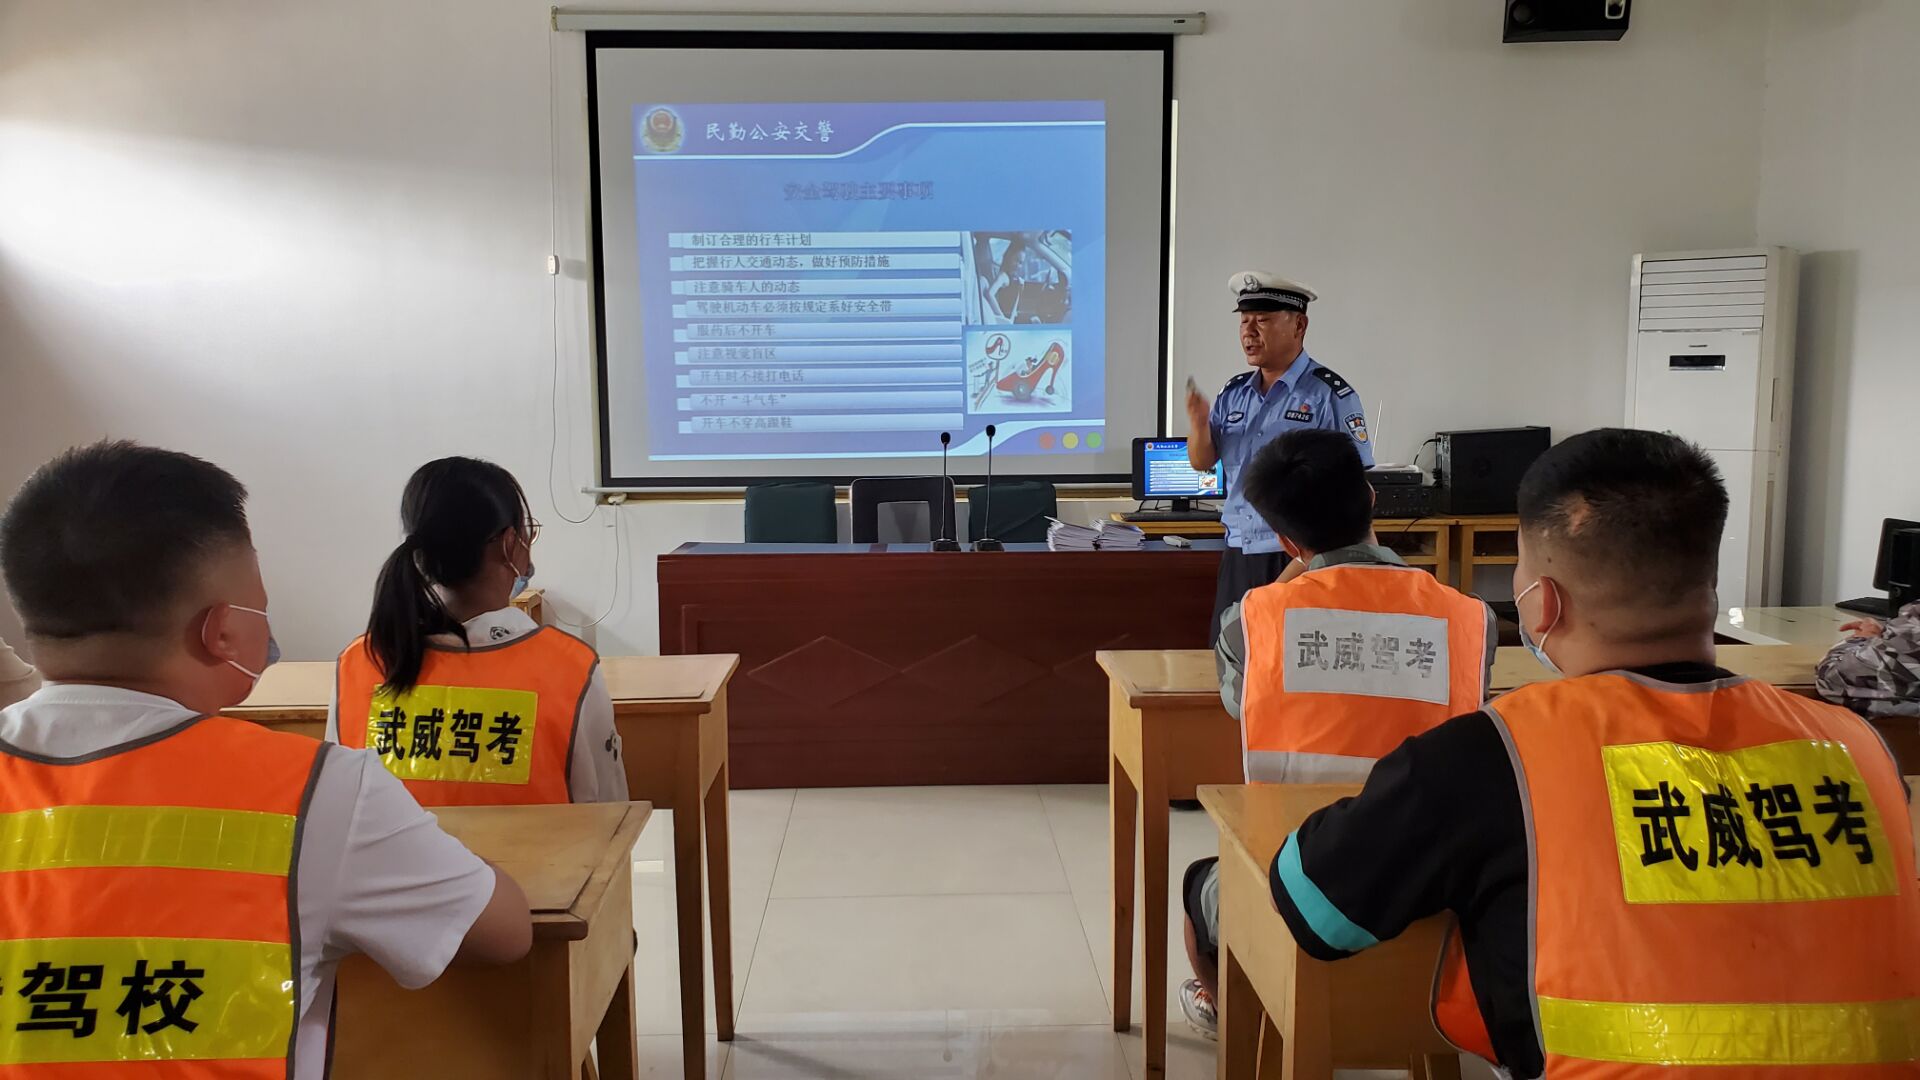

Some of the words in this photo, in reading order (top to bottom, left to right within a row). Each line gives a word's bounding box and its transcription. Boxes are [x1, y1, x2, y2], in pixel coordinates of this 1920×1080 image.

[706, 120, 833, 142] 民勤公安交警
[692, 233, 812, 247] 制订合理的行车计划
[694, 280, 800, 294] 注意骑车人的动态
[697, 300, 892, 314] 驾驶机动车必须按规定系好安全带
[697, 323, 776, 337] 服药后不开车
[698, 346, 777, 360] 注意视觉盲区
[701, 369, 804, 383] 开车时不接打电话
[703, 416, 793, 429] 开车不穿高跟鞋
[1297, 630, 1437, 679] 武威驾考
[376, 706, 523, 765] 武威驾考
[1632, 775, 1874, 872] 武威驾考
[0, 959, 206, 1038] 驾校
